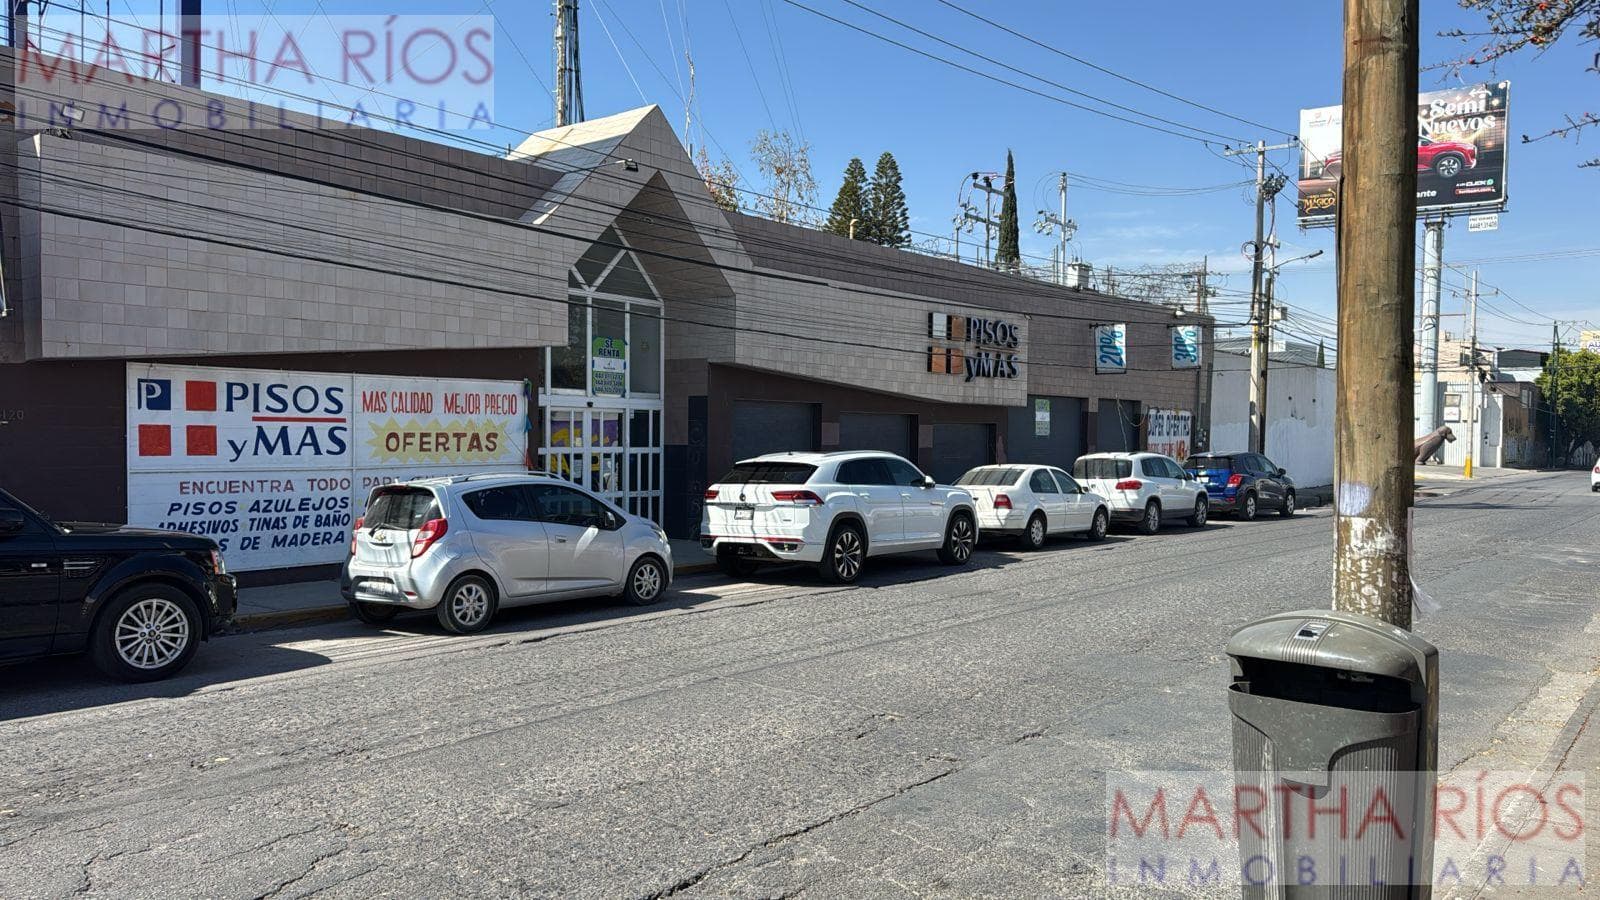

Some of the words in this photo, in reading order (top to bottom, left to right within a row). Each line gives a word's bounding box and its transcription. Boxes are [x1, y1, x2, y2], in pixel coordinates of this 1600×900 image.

[1430, 94, 1486, 118] Semi
[1418, 115, 1496, 138] Nuevos
[1416, 190, 1438, 198] ante
[968, 316, 1019, 348] PISOS
[225, 382, 344, 414] PISOS
[362, 391, 388, 414] MAS
[391, 391, 433, 414] CALIDAD
[443, 393, 480, 415] MEJOR
[484, 393, 518, 415] PRECIO
[385, 431, 499, 452] OFERTAS
[179, 479, 295, 495] ENCUENTRA
[307, 478, 350, 491] TODO
[167, 501, 238, 517] PISOS
[248, 496, 350, 514] AZULEJOS
[249, 516, 287, 532] TINAS
[292, 514, 309, 530] DE
[314, 509, 351, 528] BAÑO
[239, 536, 260, 551] DE
[271, 530, 345, 549] MADERA
